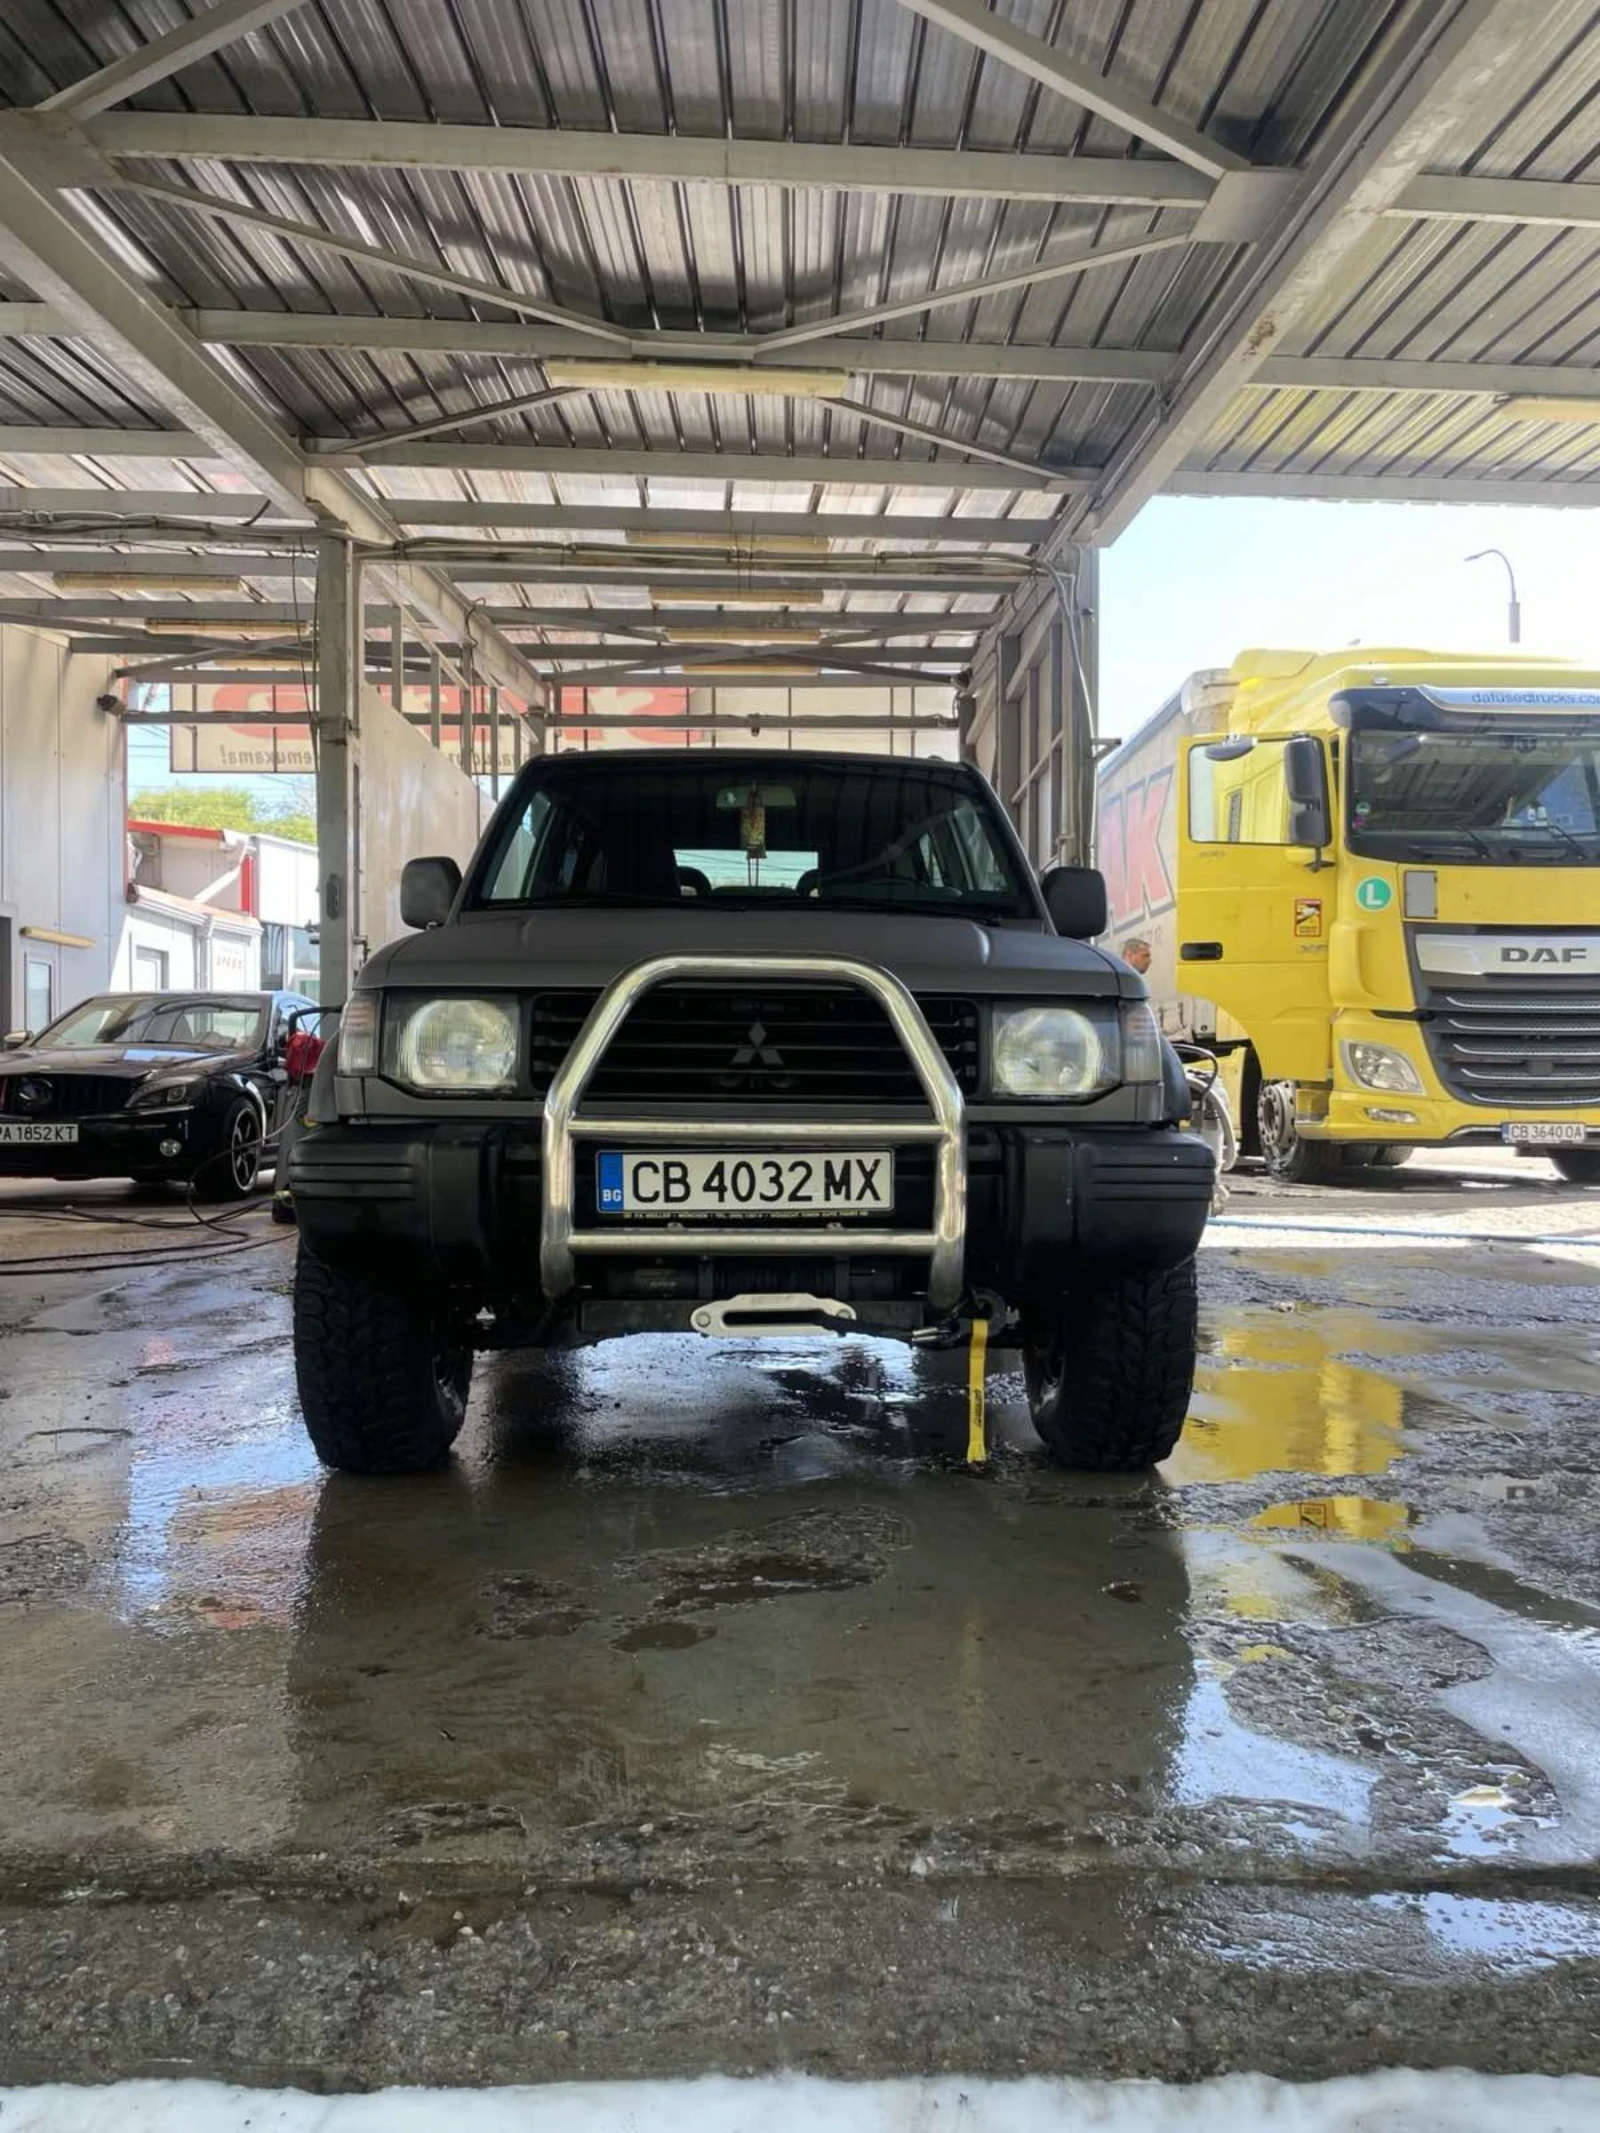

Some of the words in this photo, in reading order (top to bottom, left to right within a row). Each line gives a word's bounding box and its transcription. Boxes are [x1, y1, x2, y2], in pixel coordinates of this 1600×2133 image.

[1471, 691, 1600, 705] dafusedtrucks.co
[1366, 883, 1383, 905] L
[1501, 947, 1587, 962] DAF
[17, 1126, 52, 1140] 1852
[55, 1126, 76, 1140] KT
[1511, 1125, 1529, 1138] CB
[1531, 1125, 1563, 1138] 3640
[632, 1161, 691, 1203] CB
[702, 1160, 814, 1202] 4032
[824, 1159, 881, 1201] MX
[602, 1189, 622, 1202] BG
